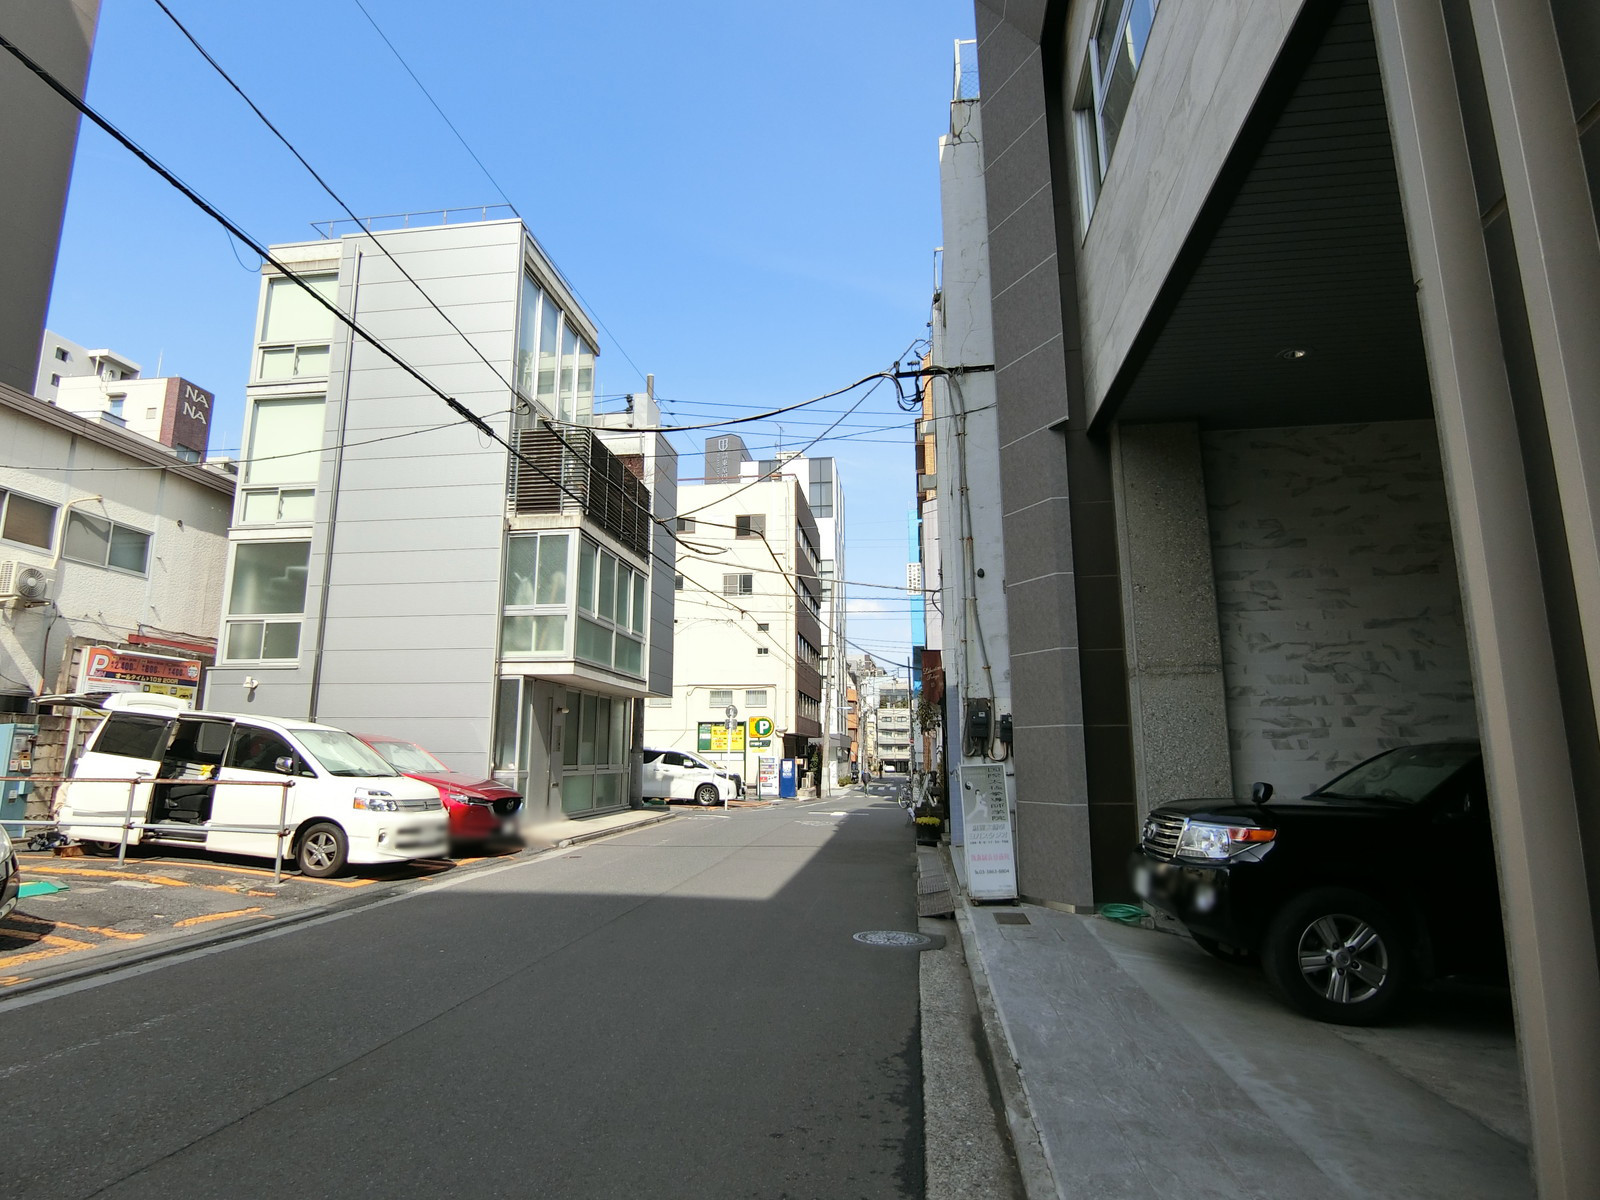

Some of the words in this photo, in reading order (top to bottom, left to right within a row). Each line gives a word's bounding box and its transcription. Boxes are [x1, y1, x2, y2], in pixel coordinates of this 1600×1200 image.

[185, 385, 209, 408] NA
[183, 402, 206, 425] NA
[89, 654, 109, 676] P
[759, 720, 770, 735] P
